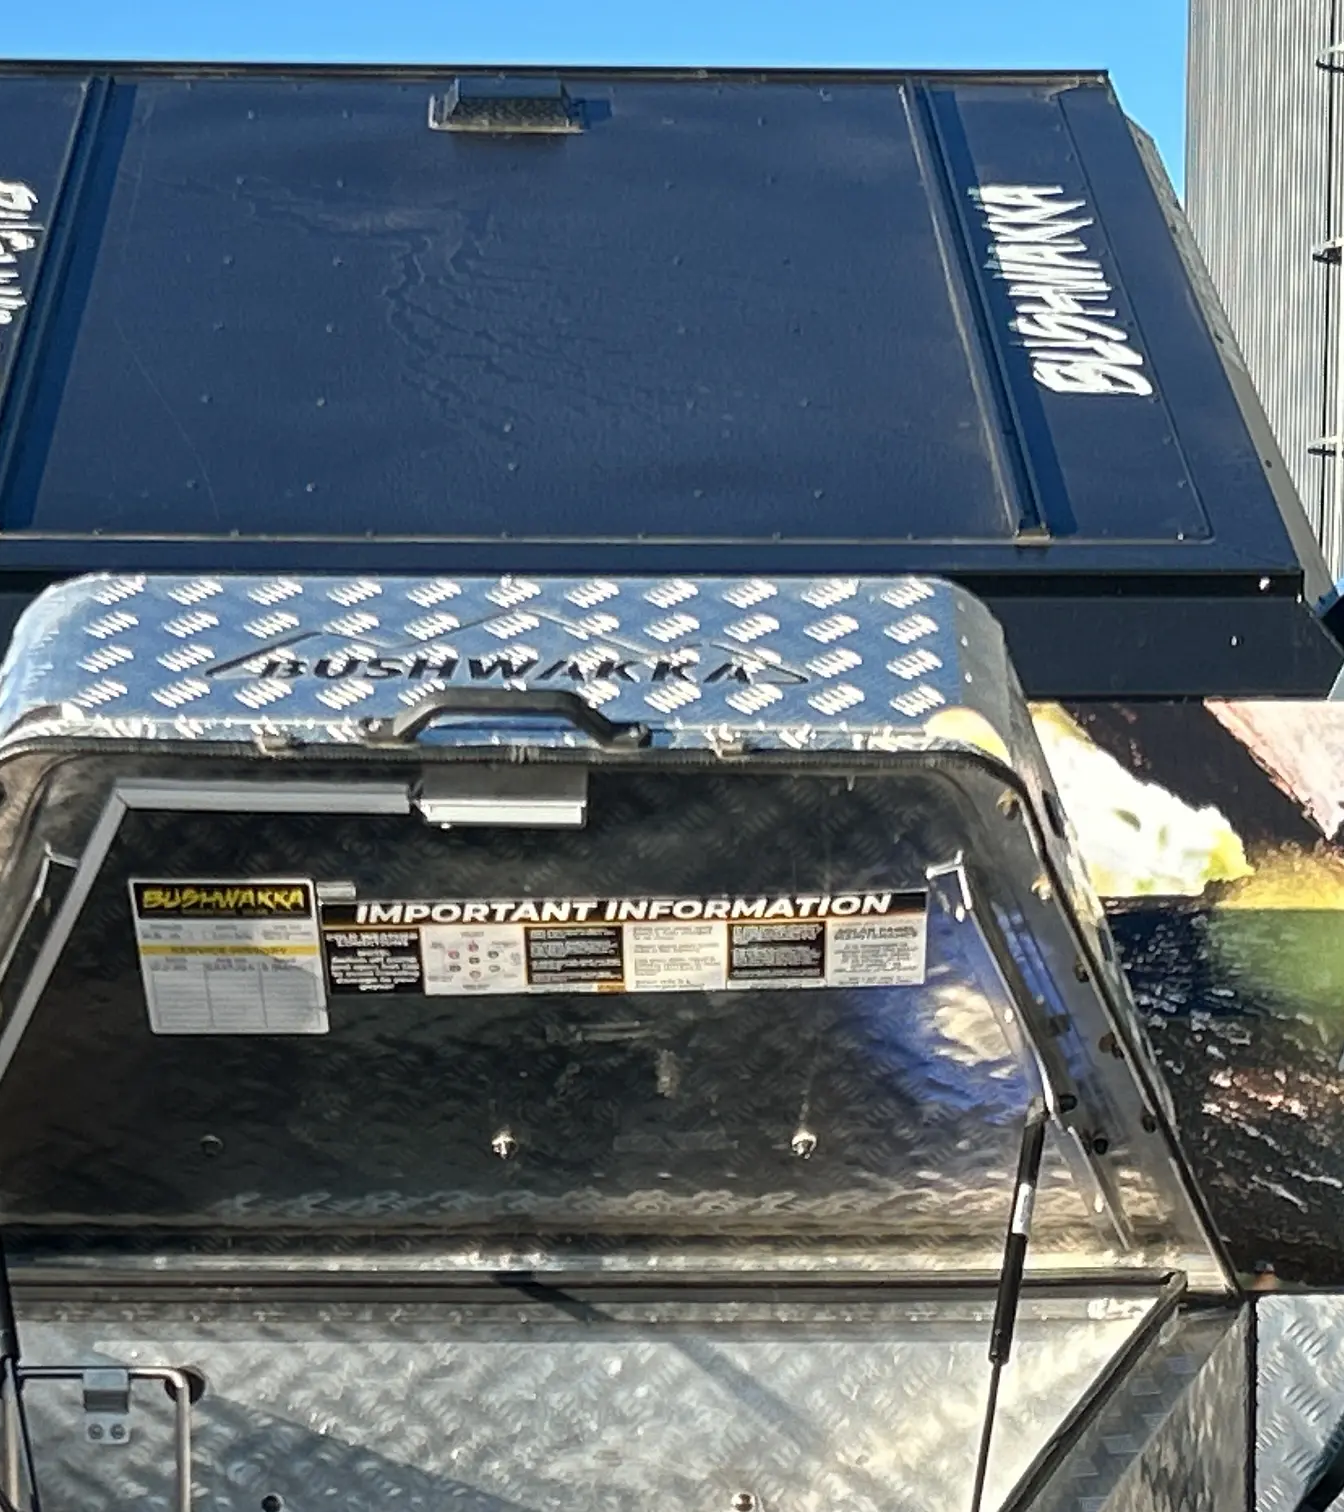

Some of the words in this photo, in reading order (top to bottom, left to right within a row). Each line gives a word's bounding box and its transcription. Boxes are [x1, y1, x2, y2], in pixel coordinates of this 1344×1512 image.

[967, 185, 1154, 396] BUSHWAKKA
[257, 656, 755, 686] BUSHWAKKA
[142, 887, 306, 910] BUSHWAKKA
[356, 900, 598, 925] IMPORTANT
[605, 894, 892, 921] INFORMATION
